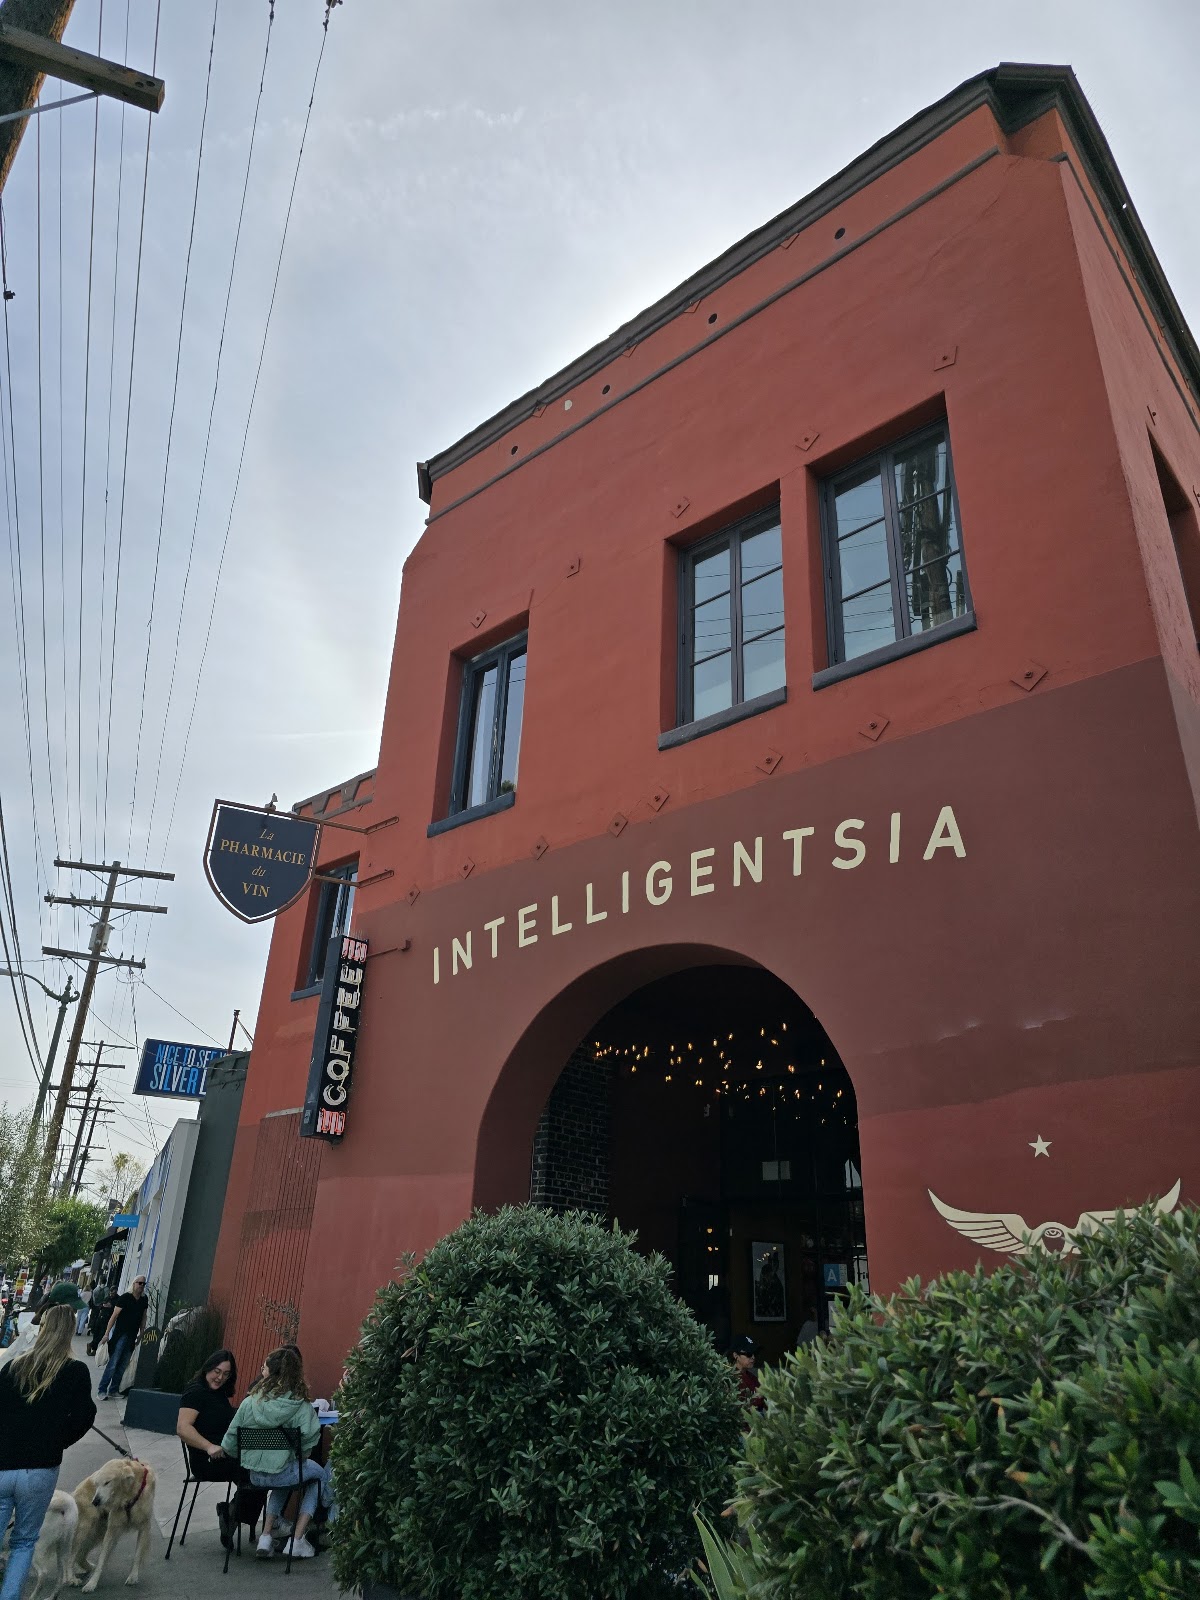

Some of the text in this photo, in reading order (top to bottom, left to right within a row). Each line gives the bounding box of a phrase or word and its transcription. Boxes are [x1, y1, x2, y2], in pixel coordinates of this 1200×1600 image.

[259, 828, 275, 841] La
[220, 839, 306, 866] PHARMACIE
[251, 865, 267, 877] du
[242, 881, 270, 898] VIN
[433, 806, 966, 984] INTELLIGENTSIA
[323, 964, 363, 1106] COFFEE
[155, 1043, 182, 1066] NICE
[182, 1047, 196, 1067] TO
[150, 1063, 199, 1094] SILVER
[827, 1269, 837, 1281] A
